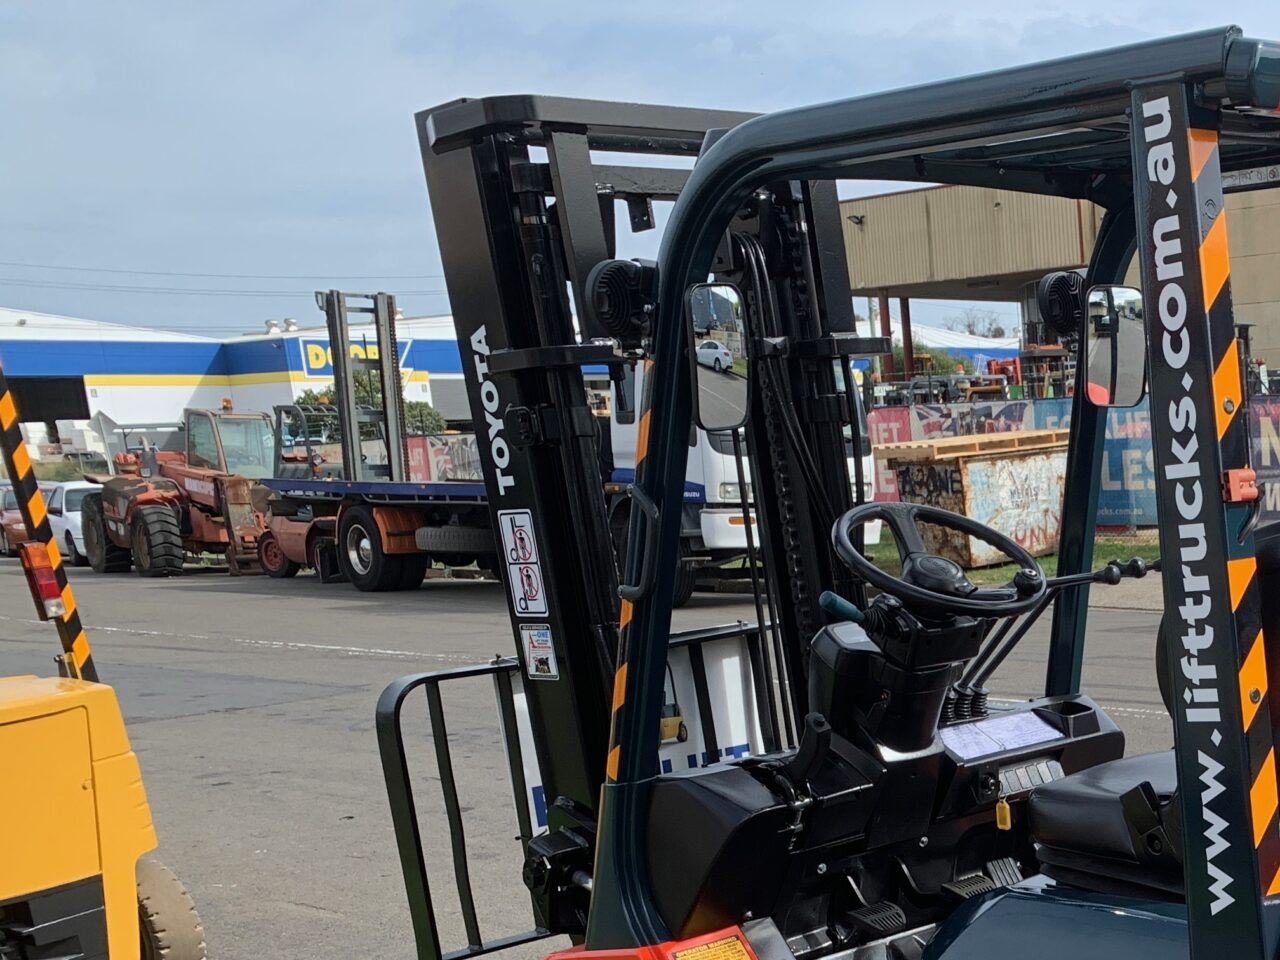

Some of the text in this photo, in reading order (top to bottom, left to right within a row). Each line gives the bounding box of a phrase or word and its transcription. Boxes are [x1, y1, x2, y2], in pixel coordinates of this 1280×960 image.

[470, 324, 515, 496] TOYOTA
[871, 422, 901, 445] IFT
[1142, 96, 1236, 916] www.lifttrucks.com.au
